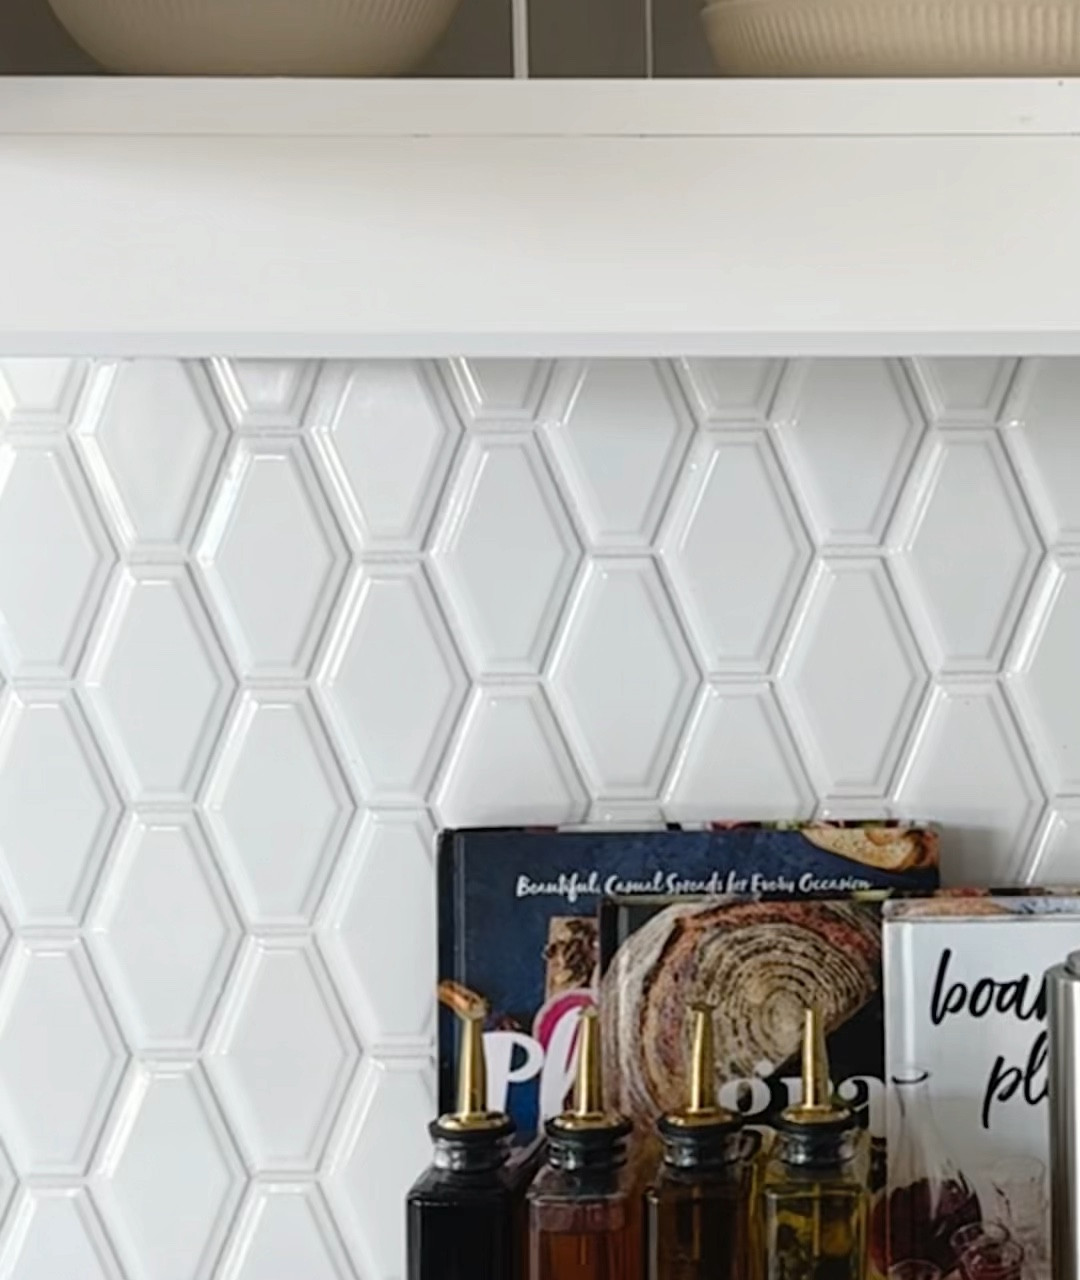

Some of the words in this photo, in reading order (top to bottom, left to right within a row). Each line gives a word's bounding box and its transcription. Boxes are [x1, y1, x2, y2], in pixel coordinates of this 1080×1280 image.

[604, 871, 664, 894] Casual
[665, 871, 723, 895] Spreads
[725, 870, 749, 894] for
[751, 873, 795, 894] Every
[799, 872, 872, 893] Occasion
